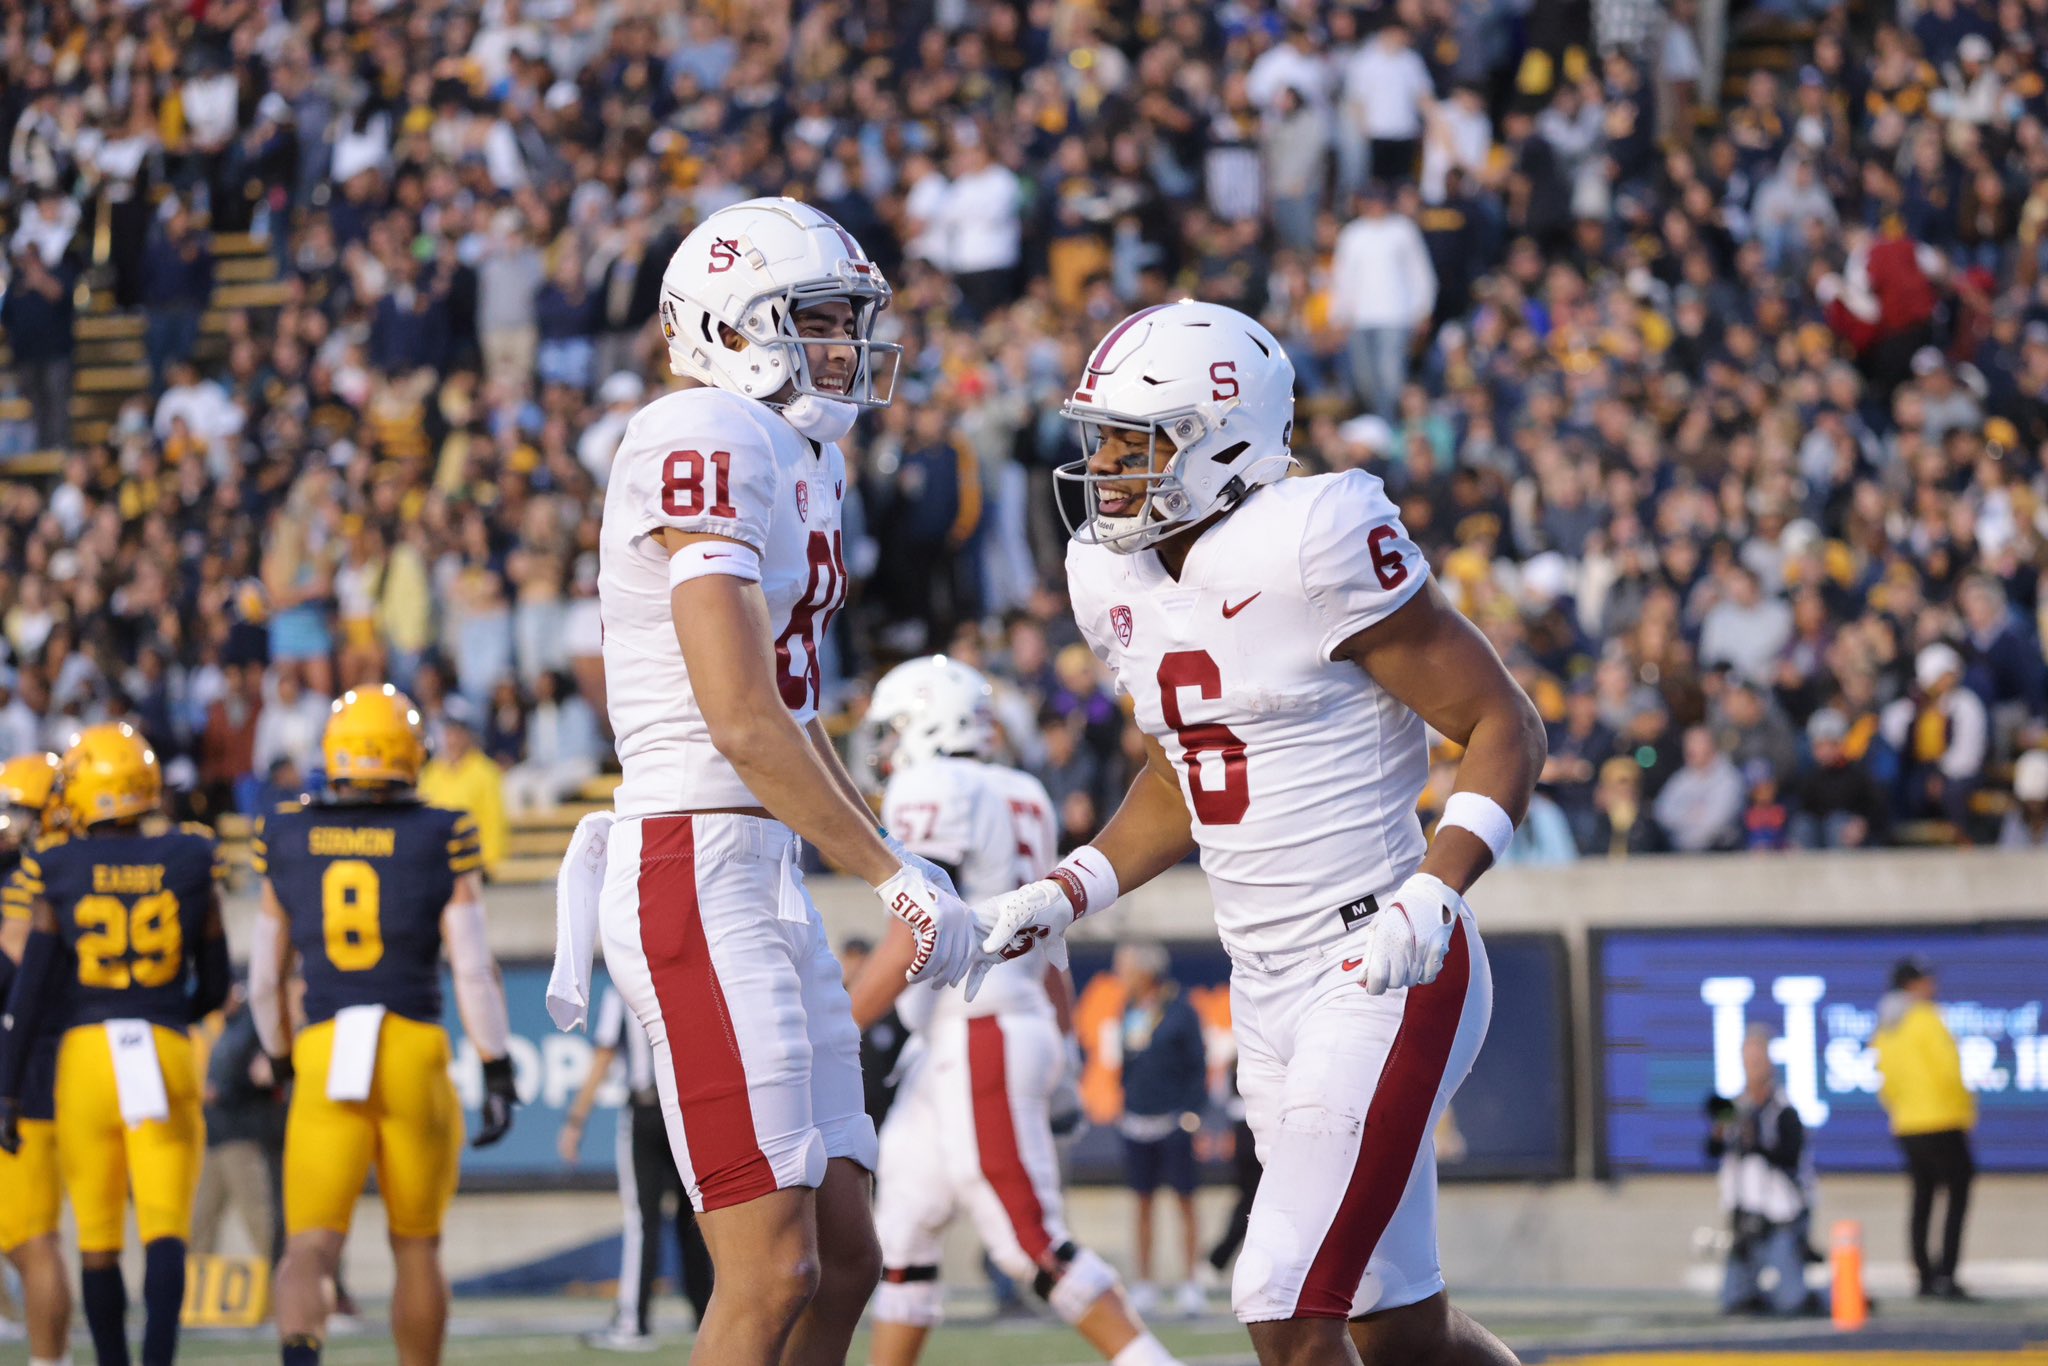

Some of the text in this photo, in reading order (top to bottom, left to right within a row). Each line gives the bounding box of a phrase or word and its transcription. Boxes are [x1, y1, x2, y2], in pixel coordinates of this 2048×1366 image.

[708, 239, 738, 274] S
[1208, 361, 1240, 402] S
[661, 450, 736, 519] 81
[1367, 524, 1408, 590] 6
[1157, 649, 1250, 825] 6
[74, 889, 182, 990] 29
[322, 860, 384, 972] 8
[1351, 902, 1367, 916] M
